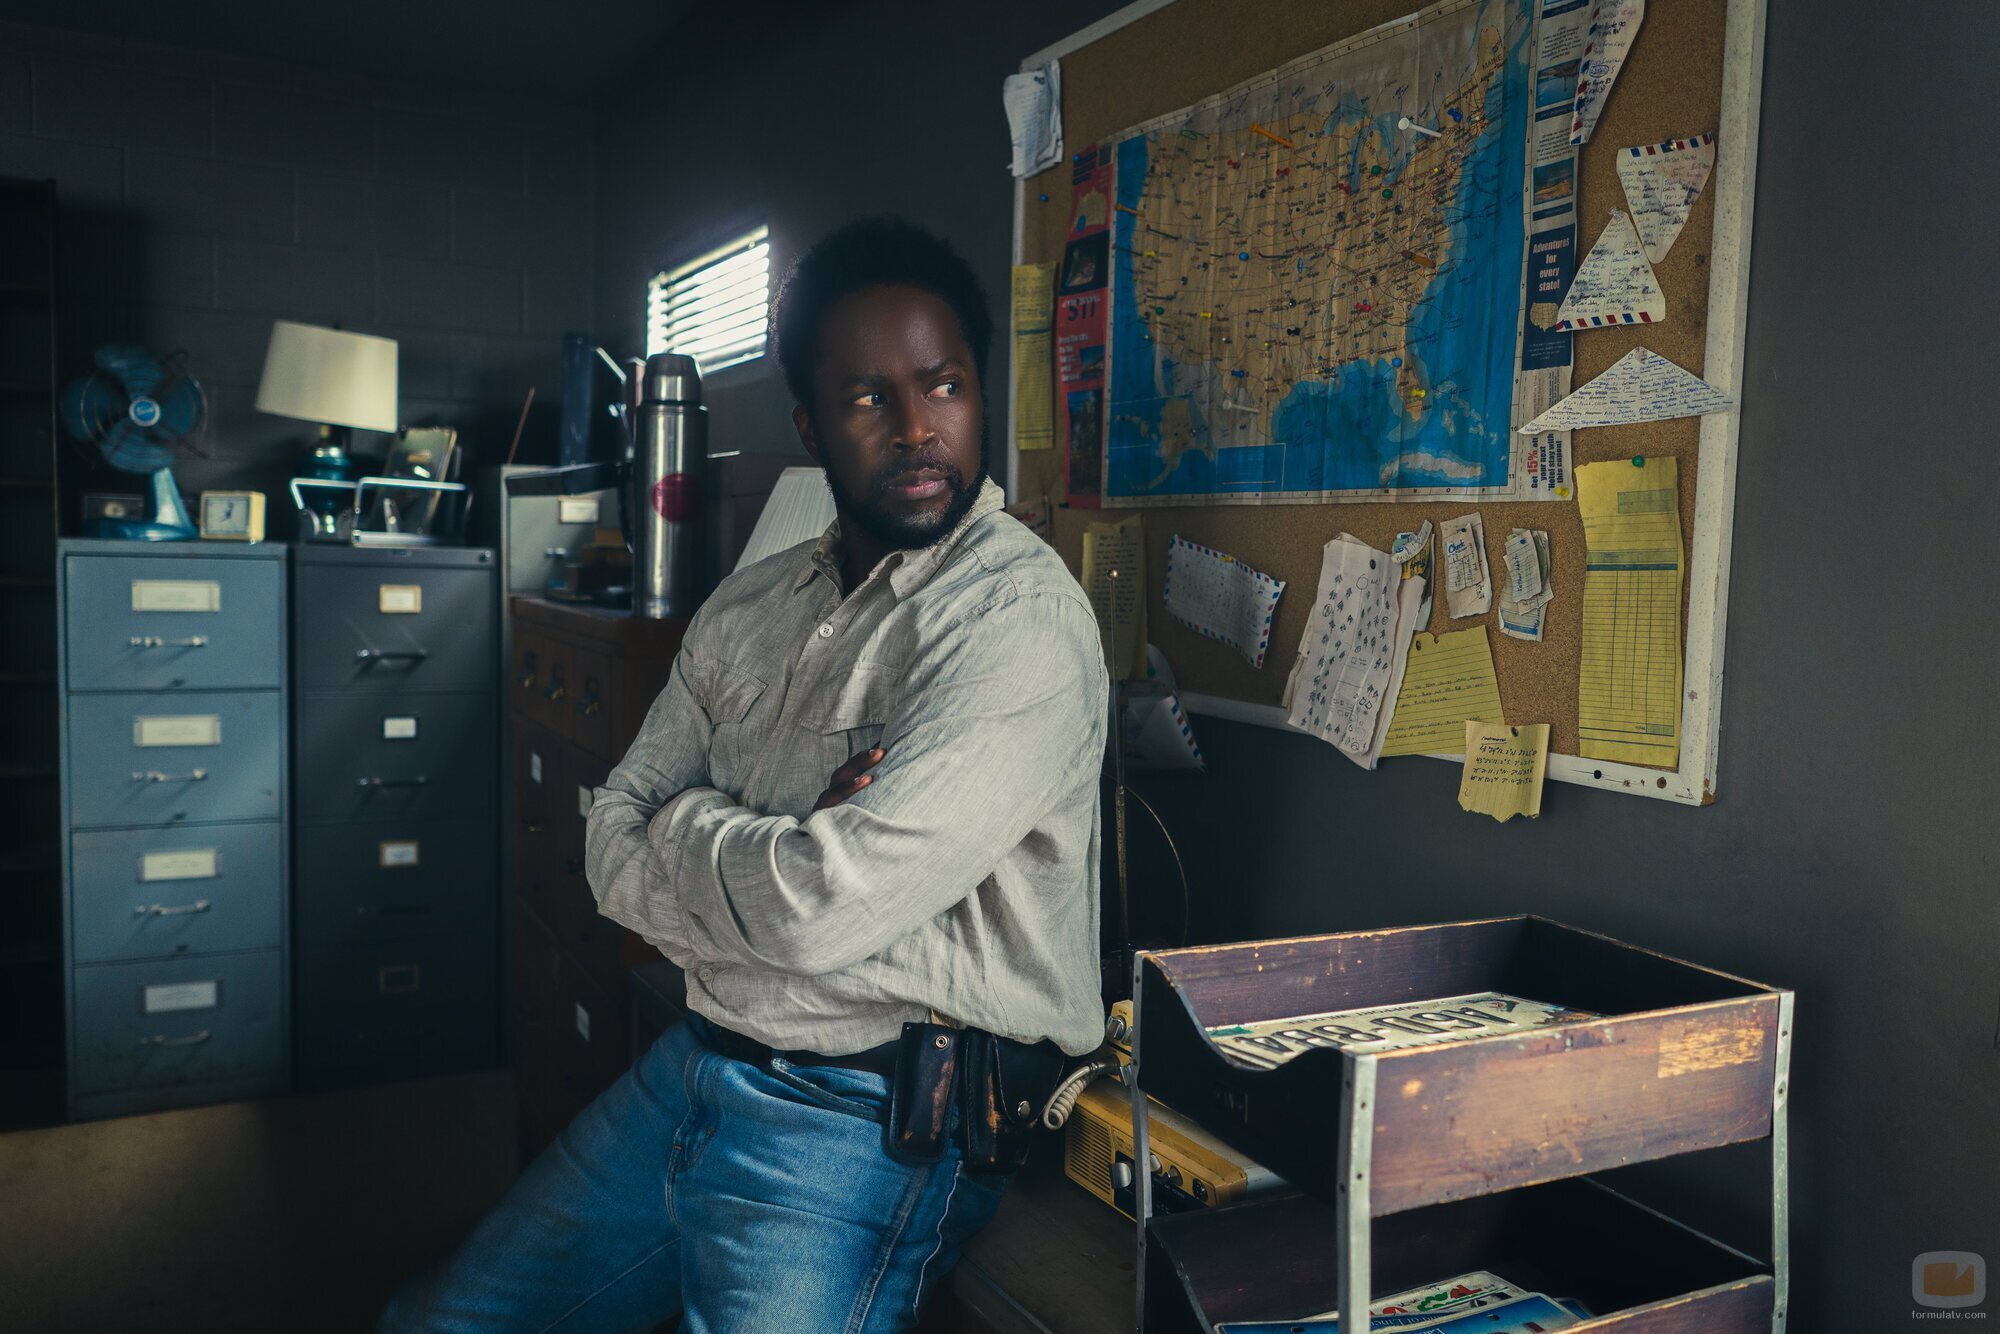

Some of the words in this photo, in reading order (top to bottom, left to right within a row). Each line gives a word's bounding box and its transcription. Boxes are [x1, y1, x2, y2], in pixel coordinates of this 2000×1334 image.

[1532, 237, 1570, 253] Adventures
[1545, 253, 1557, 263] for
[1538, 267, 1558, 279] every
[1538, 280, 1558, 292] state!
[1530, 438, 1538, 447] off
[1546, 433, 1556, 450] with
[1539, 446, 1547, 463] next
[1547, 450, 1557, 467] stay
[1527, 449, 1538, 475] 15%
[1539, 465, 1548, 481] your
[1555, 470, 1564, 483] this
[1448, 540, 1465, 554] Check
[1356, 1004, 1421, 1017] SUPPORT
